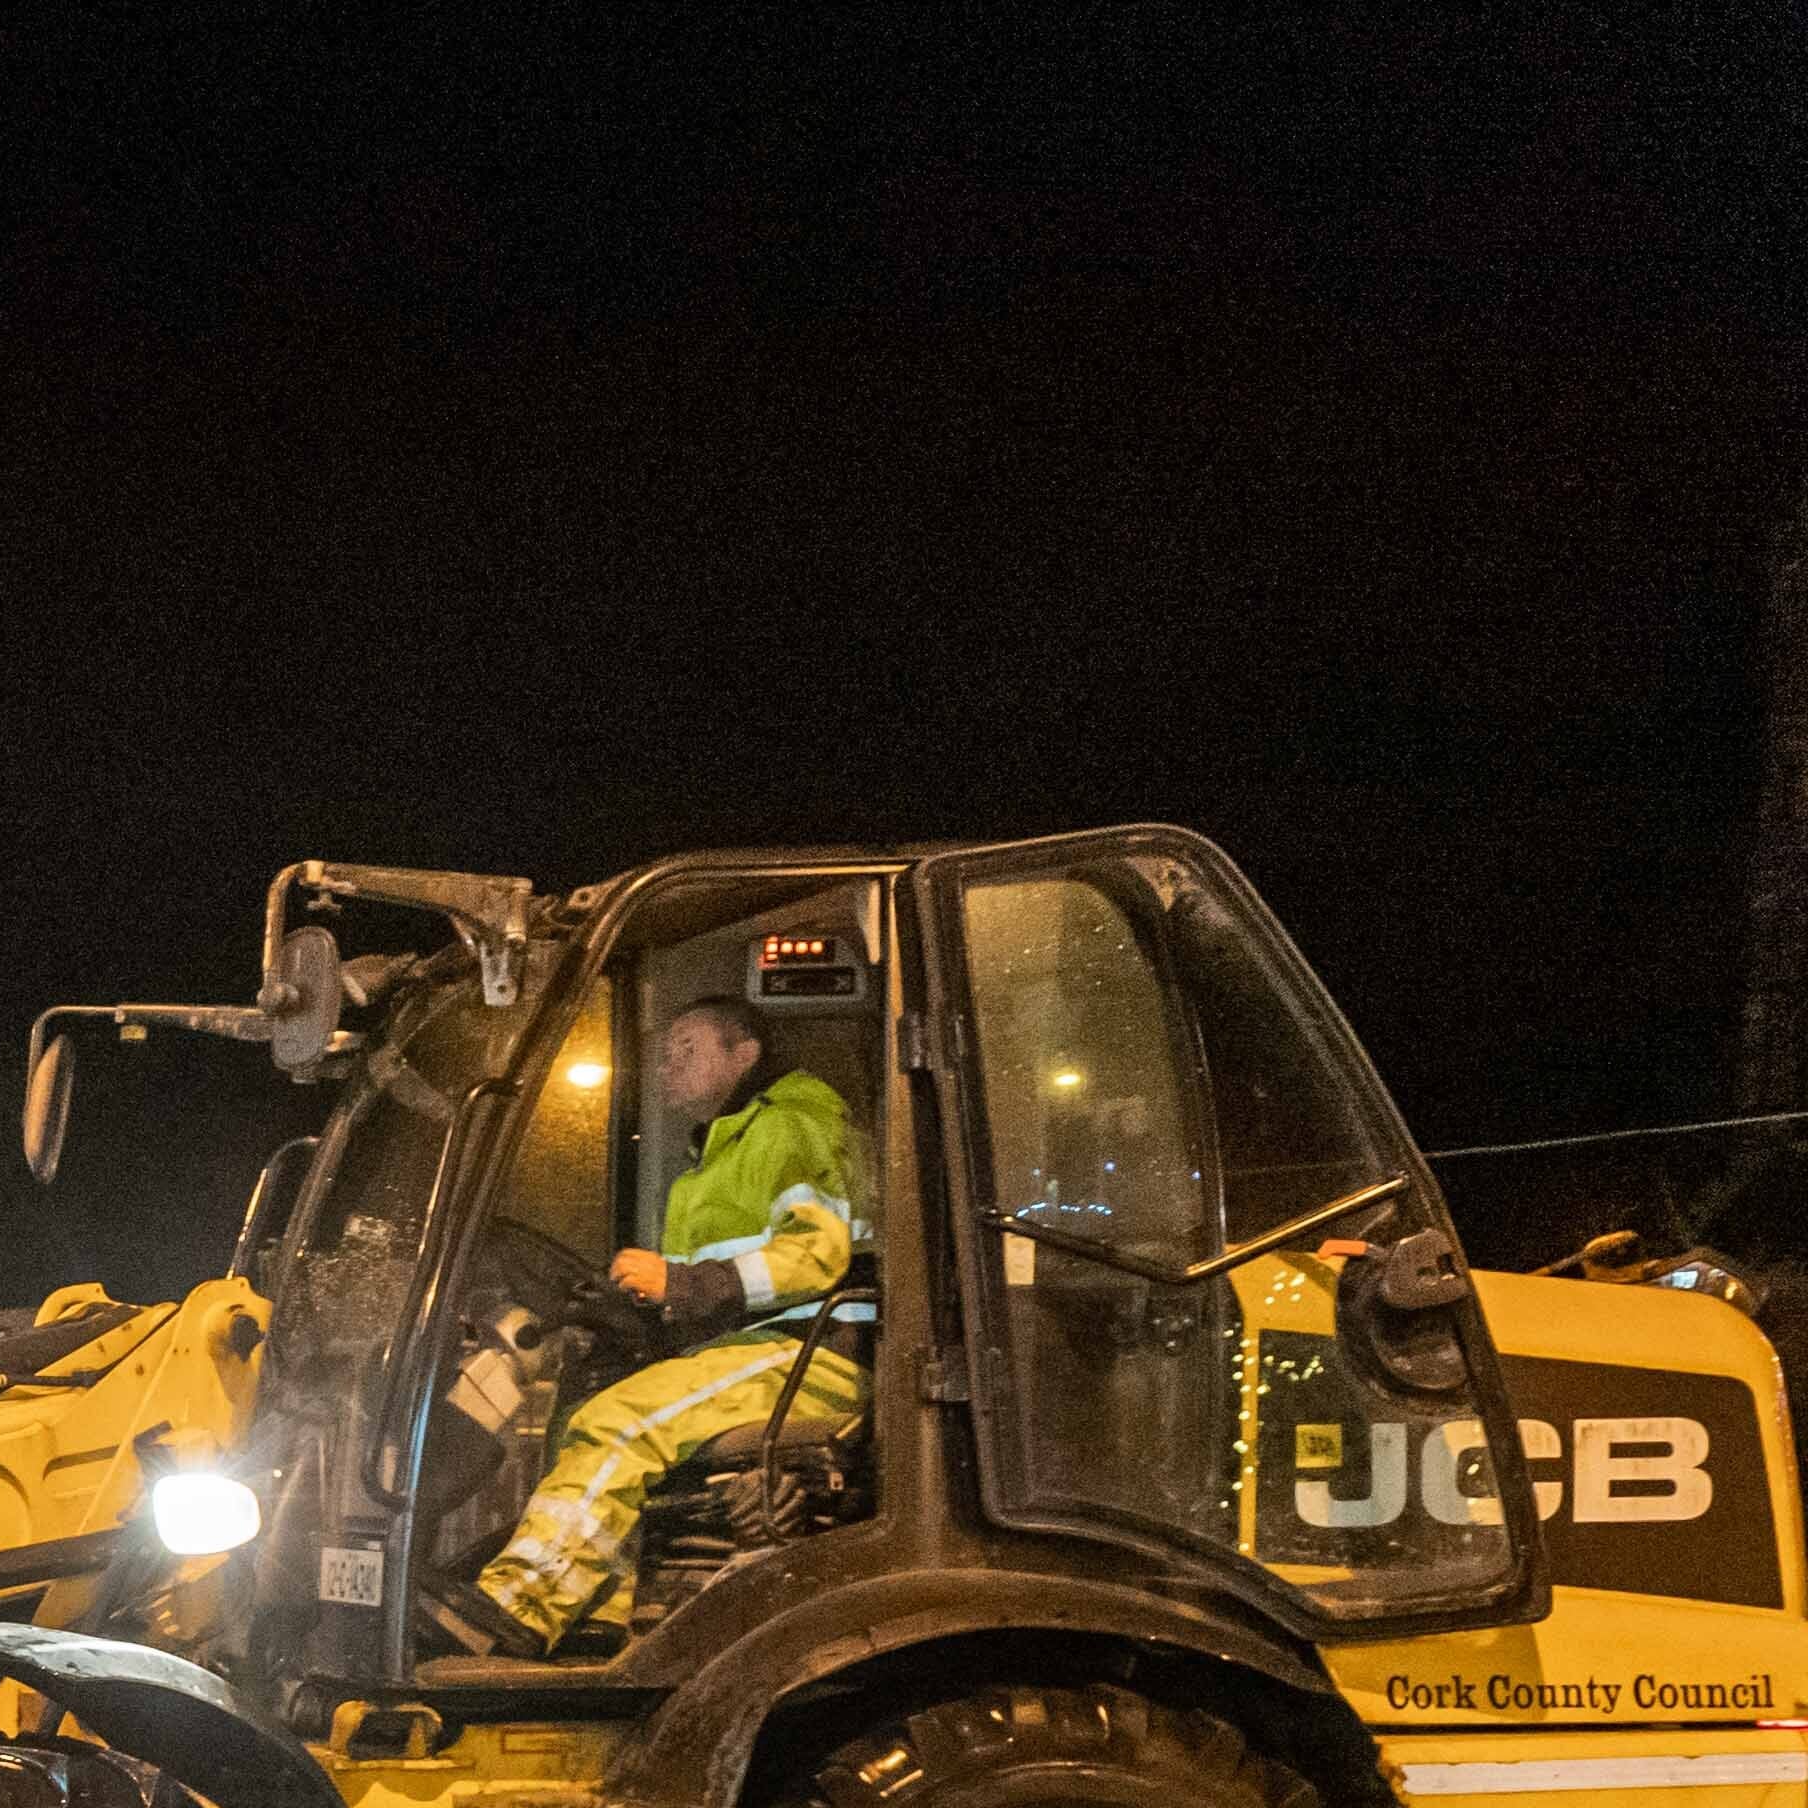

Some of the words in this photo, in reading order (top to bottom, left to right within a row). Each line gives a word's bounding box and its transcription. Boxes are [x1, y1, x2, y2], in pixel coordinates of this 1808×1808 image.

[1295, 1417, 1713, 1528] JCB
[1386, 1674, 1476, 1709] Cork
[1488, 1674, 1621, 1714] County
[1634, 1673, 1774, 1710] Council
